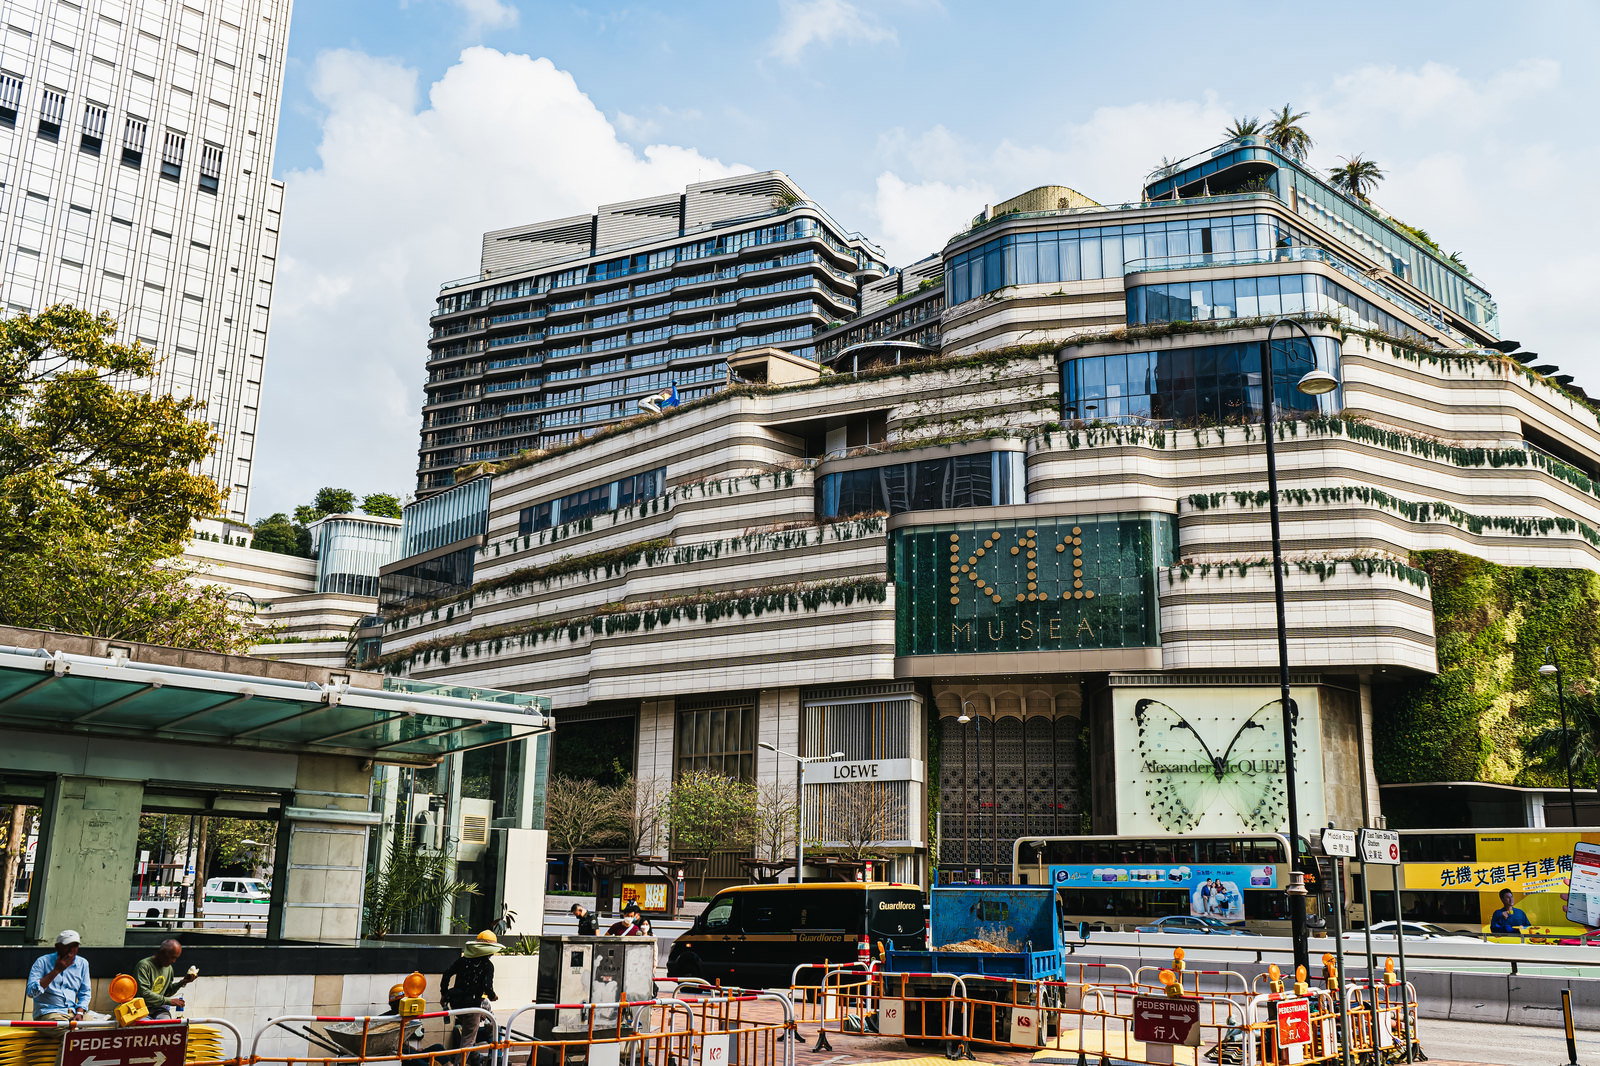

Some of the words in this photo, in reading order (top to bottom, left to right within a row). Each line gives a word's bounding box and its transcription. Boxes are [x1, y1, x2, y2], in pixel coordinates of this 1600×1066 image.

[950, 526, 1095, 605] K11
[951, 617, 1096, 643] MUSEA
[834, 763, 879, 779] LOEWE
[1140, 759, 1213, 774] Alexander
[1328, 832, 1341, 840] Middle
[1343, 833, 1353, 841] Road
[646, 884, 667, 893] WHY
[646, 892, 665, 901] NOT
[879, 901, 916, 911] Guardforce
[799, 933, 842, 942] Guardforce
[1137, 1001, 1196, 1013] PEDESTRIANS
[1279, 1004, 1307, 1014] PEDESTRIANS
[1017, 1015, 1031, 1027] KS
[1154, 1025, 1180, 1041] 行人
[69, 1033, 182, 1051] PEDESTRIANS
